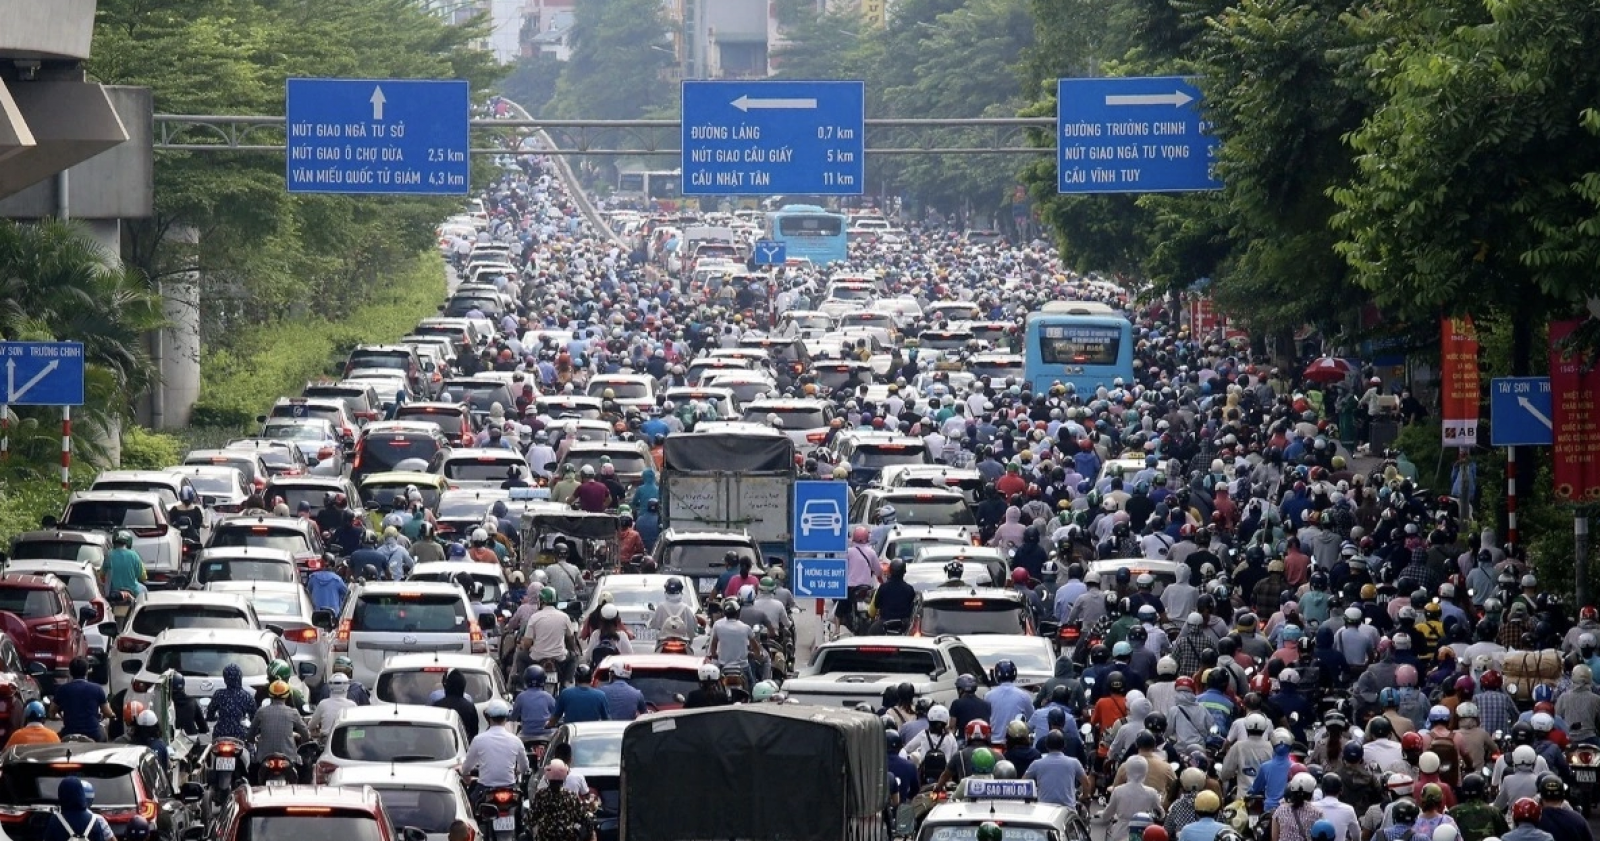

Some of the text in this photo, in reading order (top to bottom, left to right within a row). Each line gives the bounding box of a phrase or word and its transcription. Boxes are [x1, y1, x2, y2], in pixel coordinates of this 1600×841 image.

[292, 120, 405, 137] NÚT GIAO NGÃ TƯ SỞ
[691, 123, 853, 139] ĐƯỜNG LÁNG 0,7 km
[1065, 120, 1101, 136] ĐƯỜNG
[1106, 119, 1148, 135] TRƯỜNG
[1153, 123, 1184, 135] CHINH
[292, 144, 463, 162] NÚT GIAO Ô CHỢ DỪA 2,5 km
[692, 146, 853, 162] NÚT GIAO CẦU GIẤY 5 km
[1065, 144, 1086, 159] NÚT
[1090, 147, 1113, 159] GIAO
[1118, 143, 1138, 158] NGÃ
[1143, 146, 1157, 158] TƯ
[1161, 146, 1189, 161] VỌNG
[293, 166, 463, 185] VĂN MIẾU QUỐC TỬ GIÁM 4,3 km
[692, 169, 853, 186] CẦU NHẬT TÂN 11 km
[1065, 166, 1085, 182] CẦU
[1091, 167, 1115, 182] VĨNH
[1121, 170, 1140, 181] TUY
[60, 347, 80, 356] CHINH
[1498, 381, 1511, 393] TÂY
[987, 785, 1001, 795] SAO
